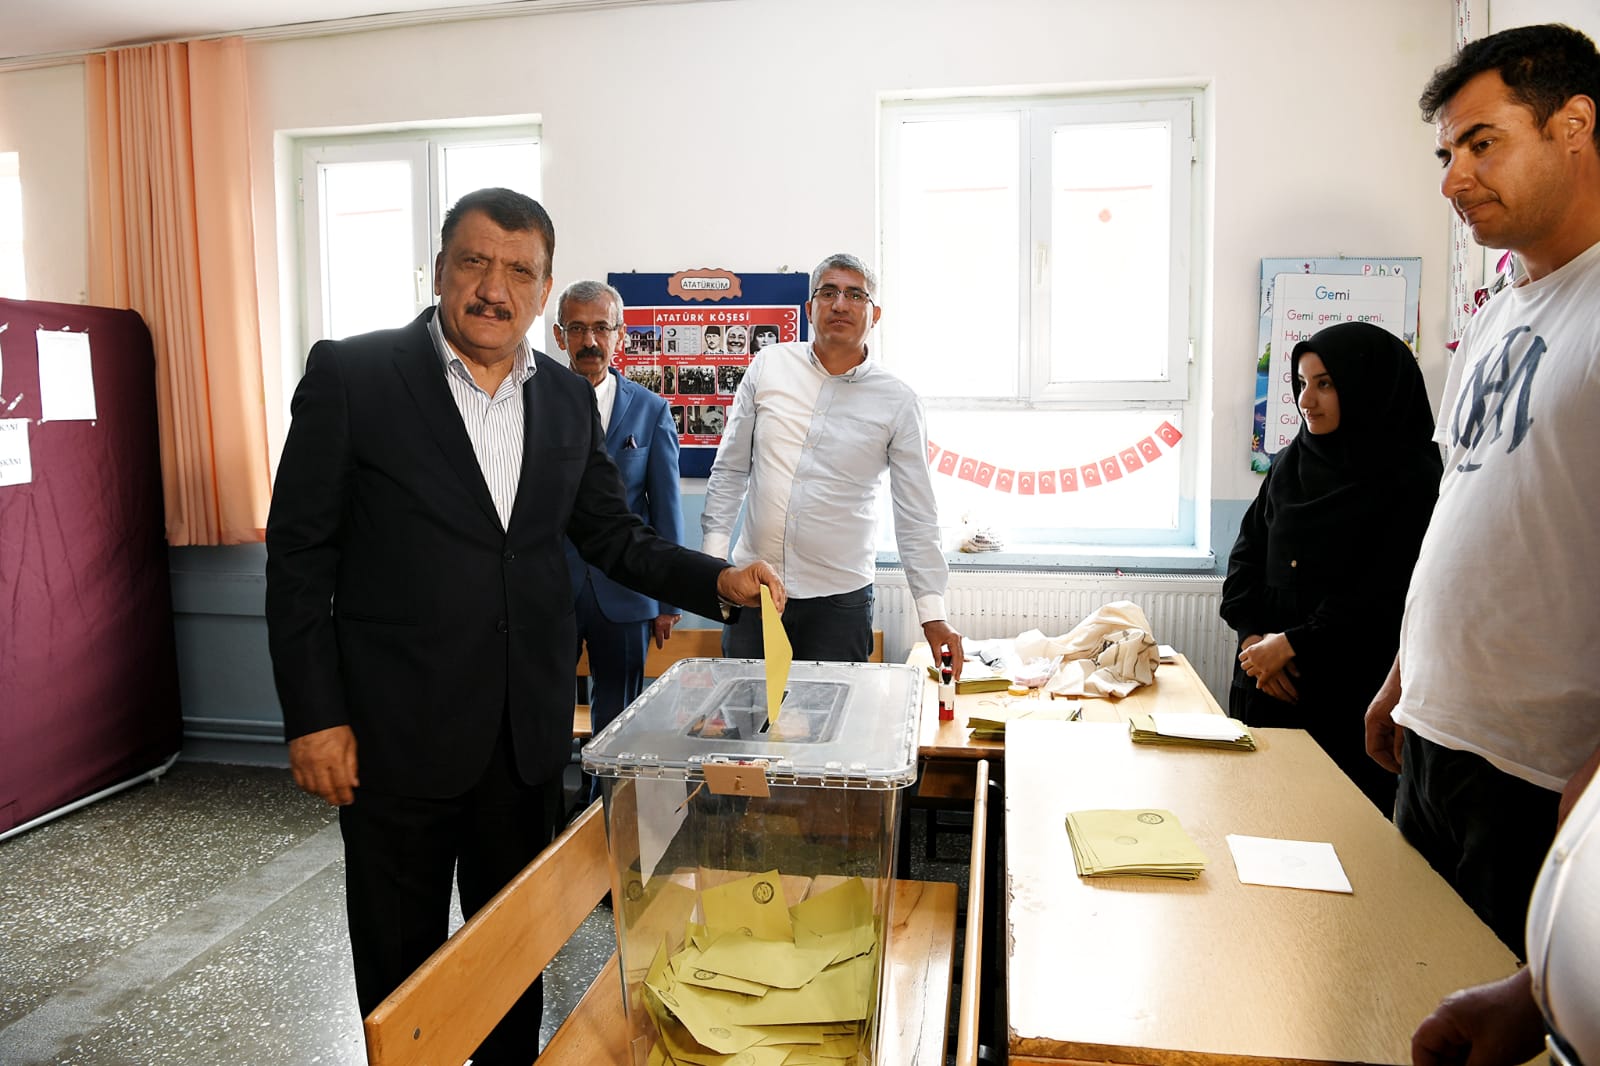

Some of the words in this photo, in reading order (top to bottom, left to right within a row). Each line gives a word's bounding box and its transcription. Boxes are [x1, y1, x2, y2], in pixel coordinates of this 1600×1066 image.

[1378, 266, 1386, 276] h
[682, 280, 728, 289] ATATÜRKÜM
[1315, 286, 1350, 300] Gemi
[656, 312, 704, 322] ATATÜRK
[709, 311, 749, 323] KÖŞESİ
[1287, 309, 1313, 321] Gemi
[1318, 312, 1342, 325] gemi
[1346, 314, 1353, 322] a
